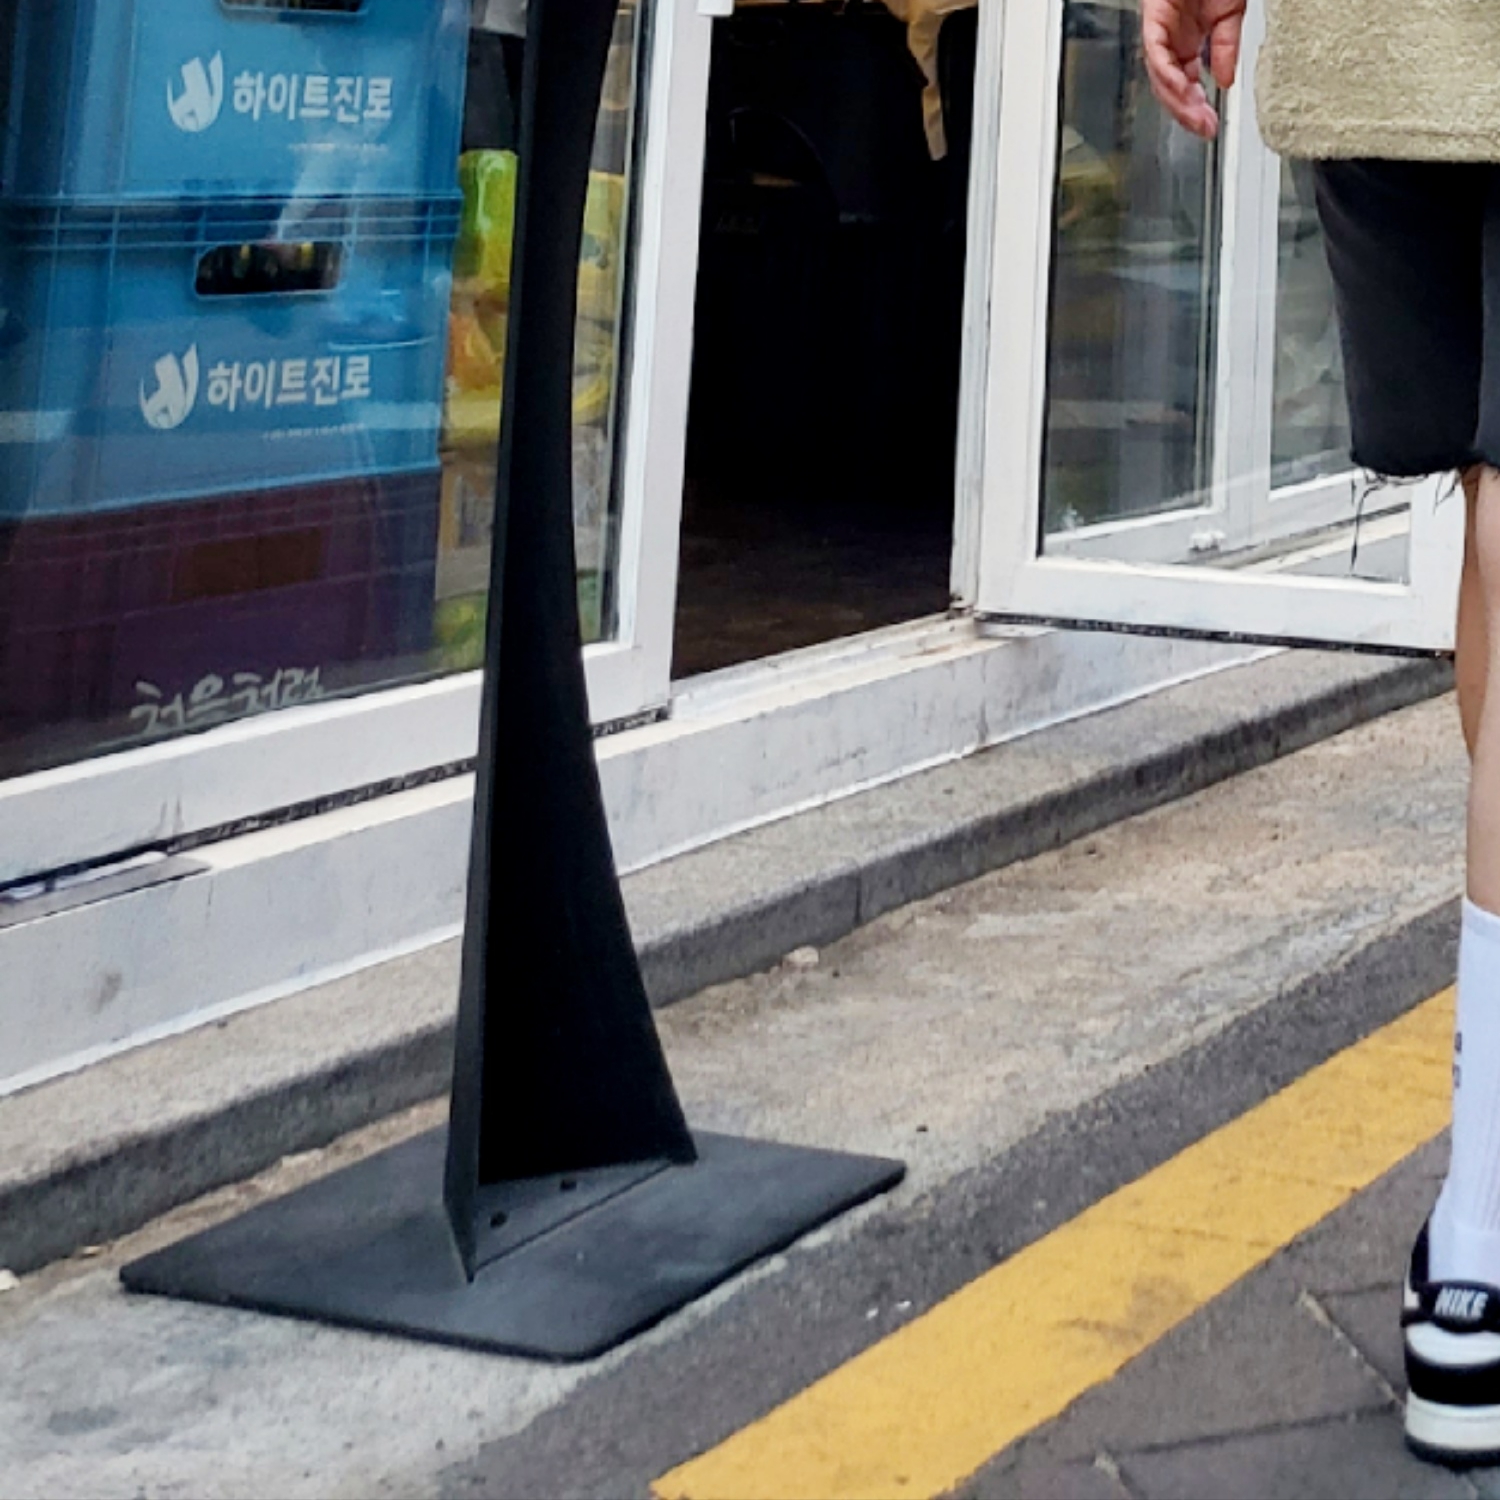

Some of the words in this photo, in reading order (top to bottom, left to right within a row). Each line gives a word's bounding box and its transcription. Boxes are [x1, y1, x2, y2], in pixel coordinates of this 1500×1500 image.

[233, 70, 393, 123] 하이트진로
[207, 355, 370, 412] 하이트진로
[1435, 1286, 1488, 1318] NIKE
